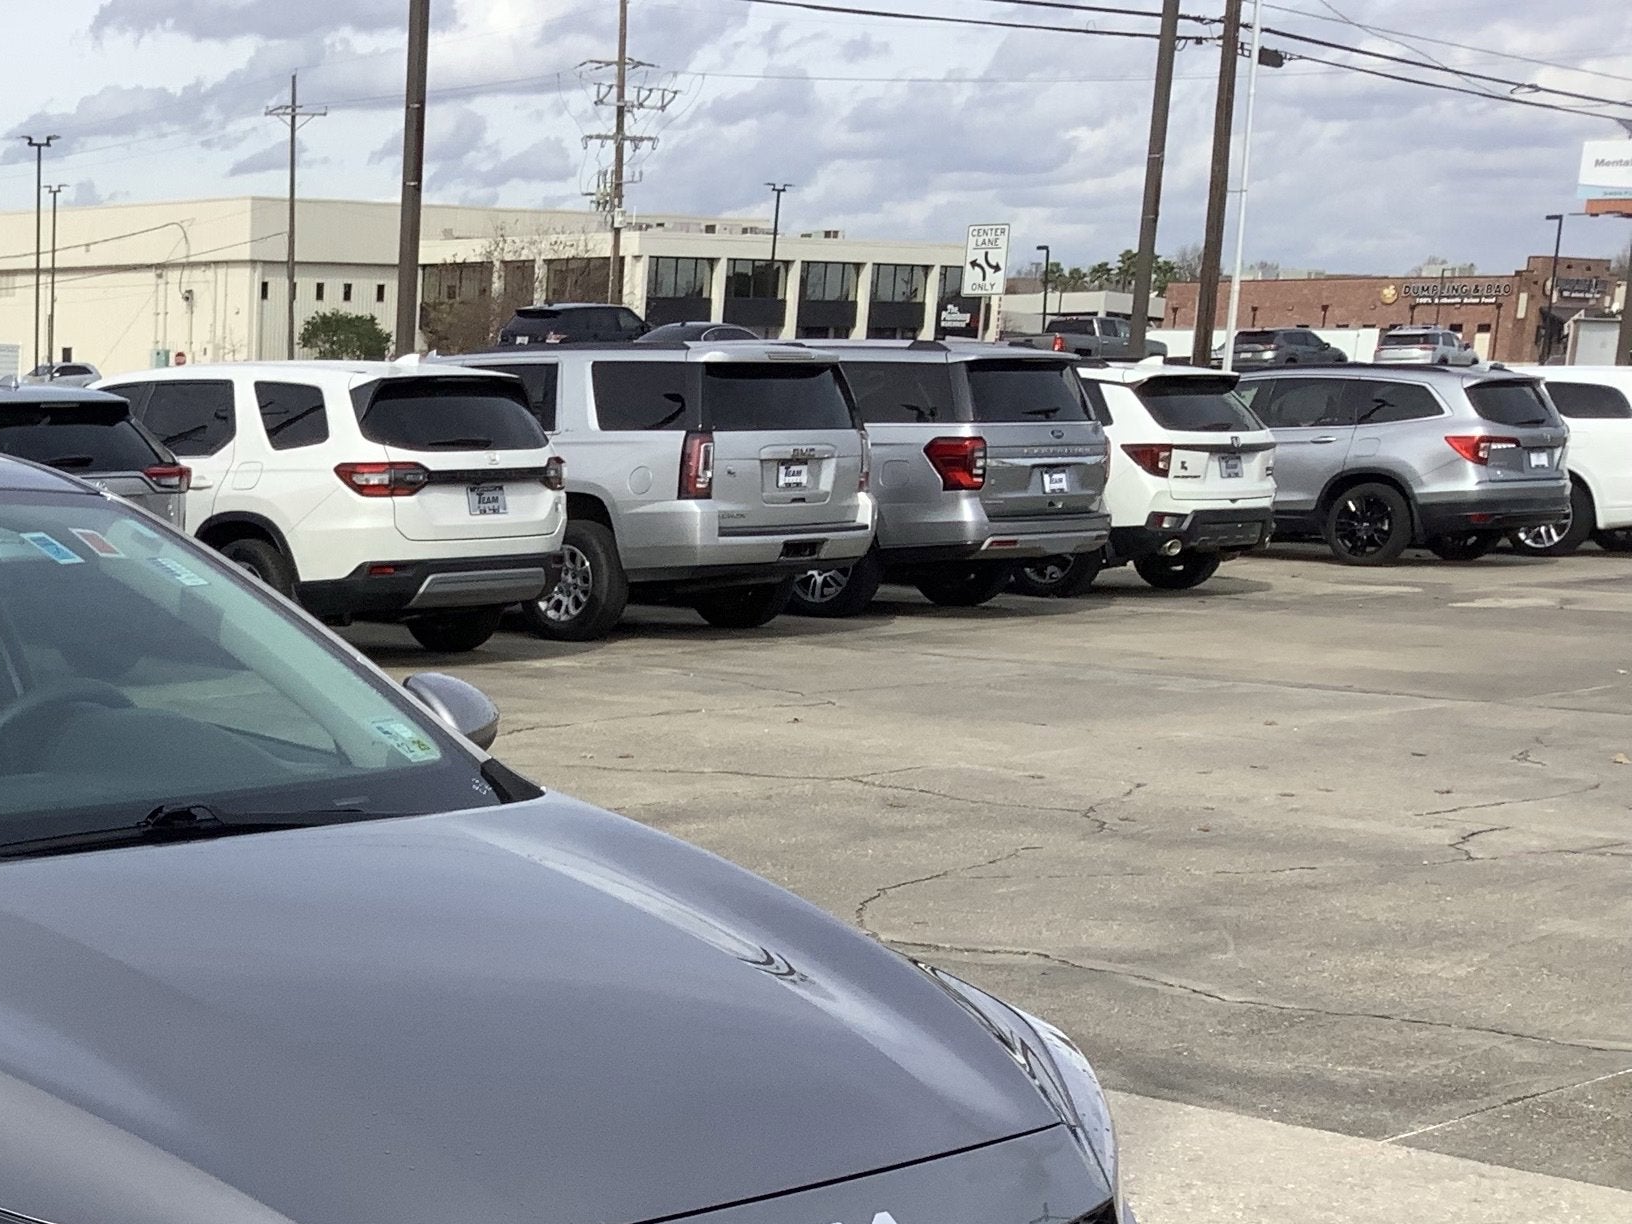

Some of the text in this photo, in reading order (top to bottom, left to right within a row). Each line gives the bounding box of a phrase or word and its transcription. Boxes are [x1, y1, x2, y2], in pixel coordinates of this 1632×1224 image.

[971, 228, 1006, 238] CENTER
[975, 238, 1000, 247] LANE
[971, 283, 996, 291] ONLY
[1485, 283, 1512, 296] BAO
[476, 492, 499, 505] TEAM
